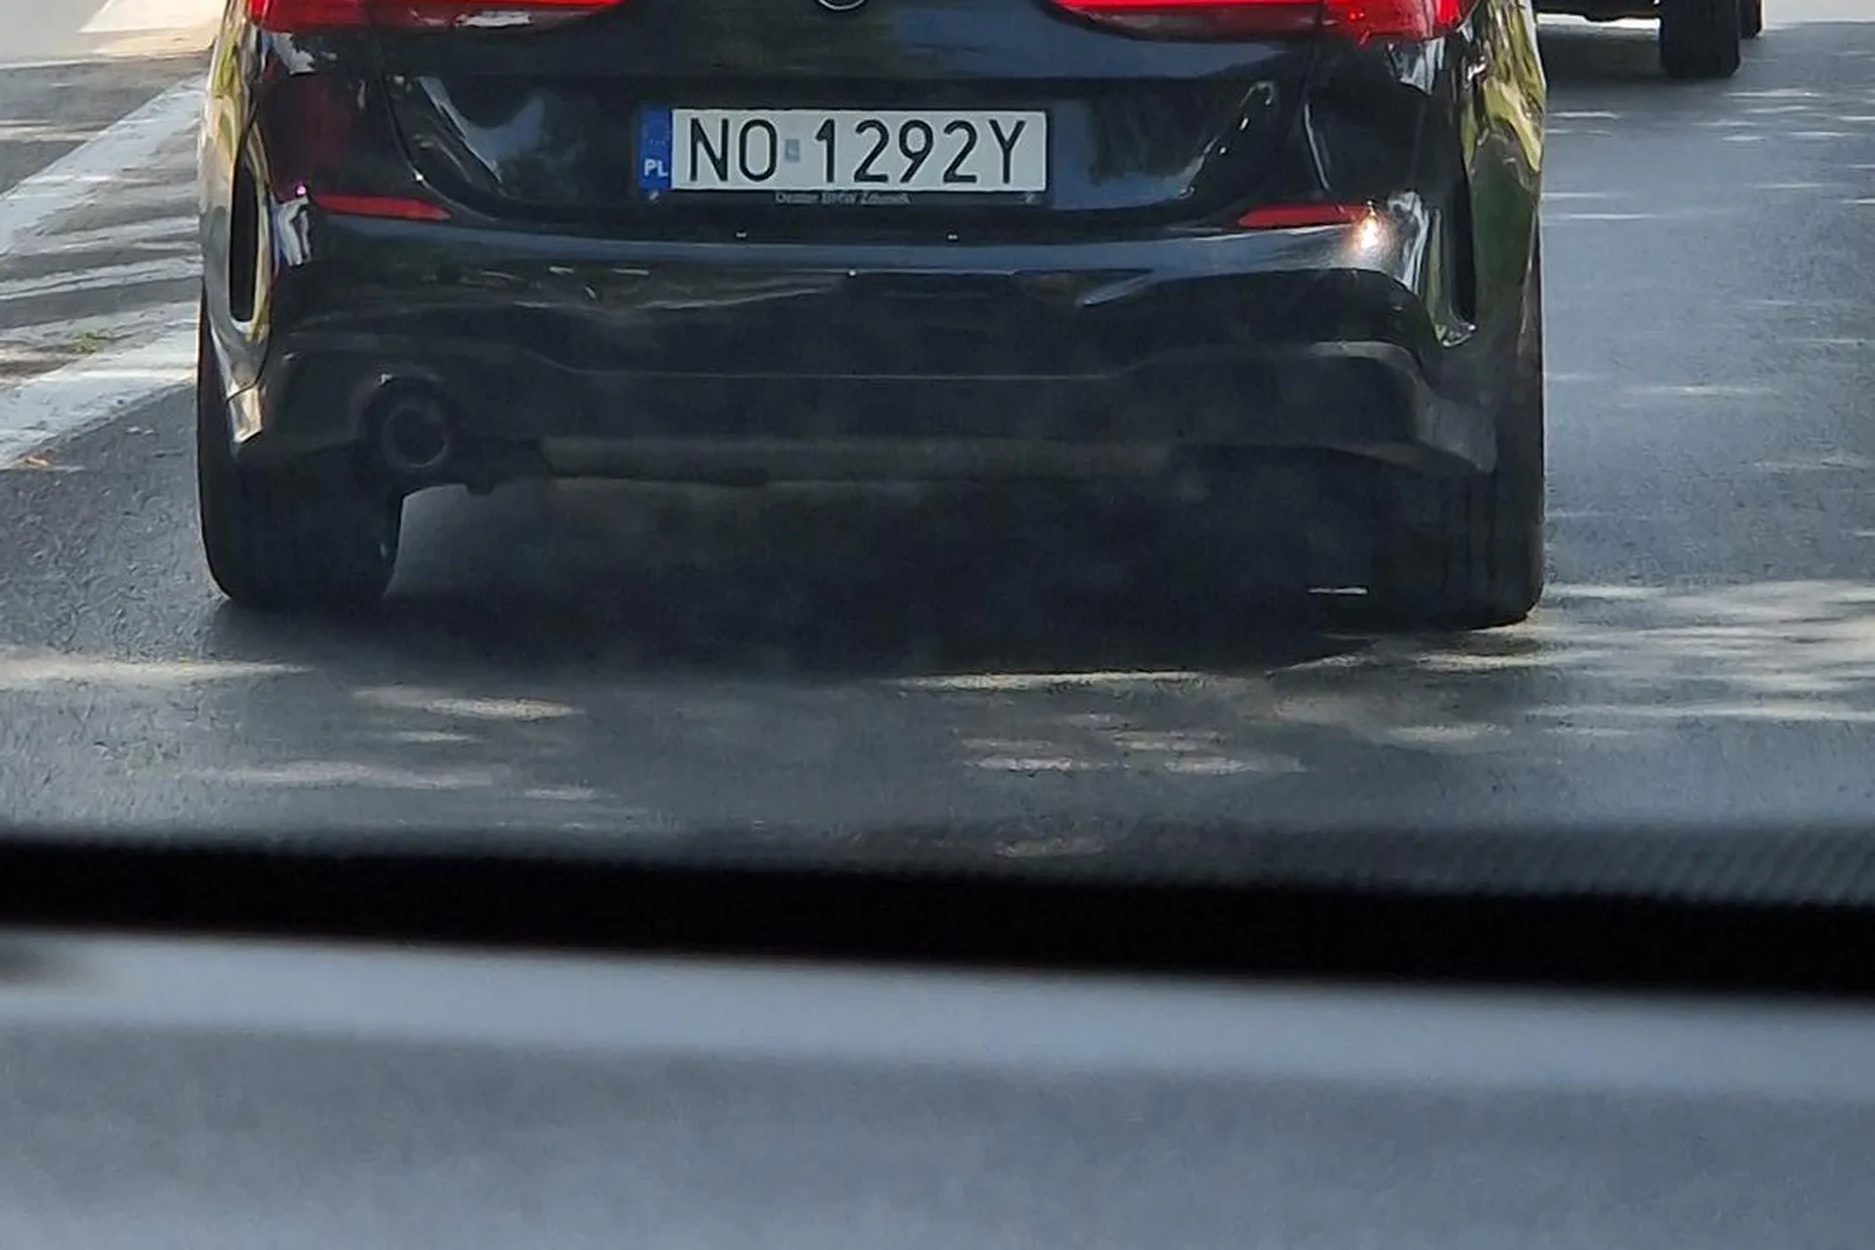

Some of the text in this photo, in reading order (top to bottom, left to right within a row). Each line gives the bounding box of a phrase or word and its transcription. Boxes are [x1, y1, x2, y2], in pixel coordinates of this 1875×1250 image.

[644, 158, 668, 177] PL
[690, 118, 1027, 184] NO 1292Y
